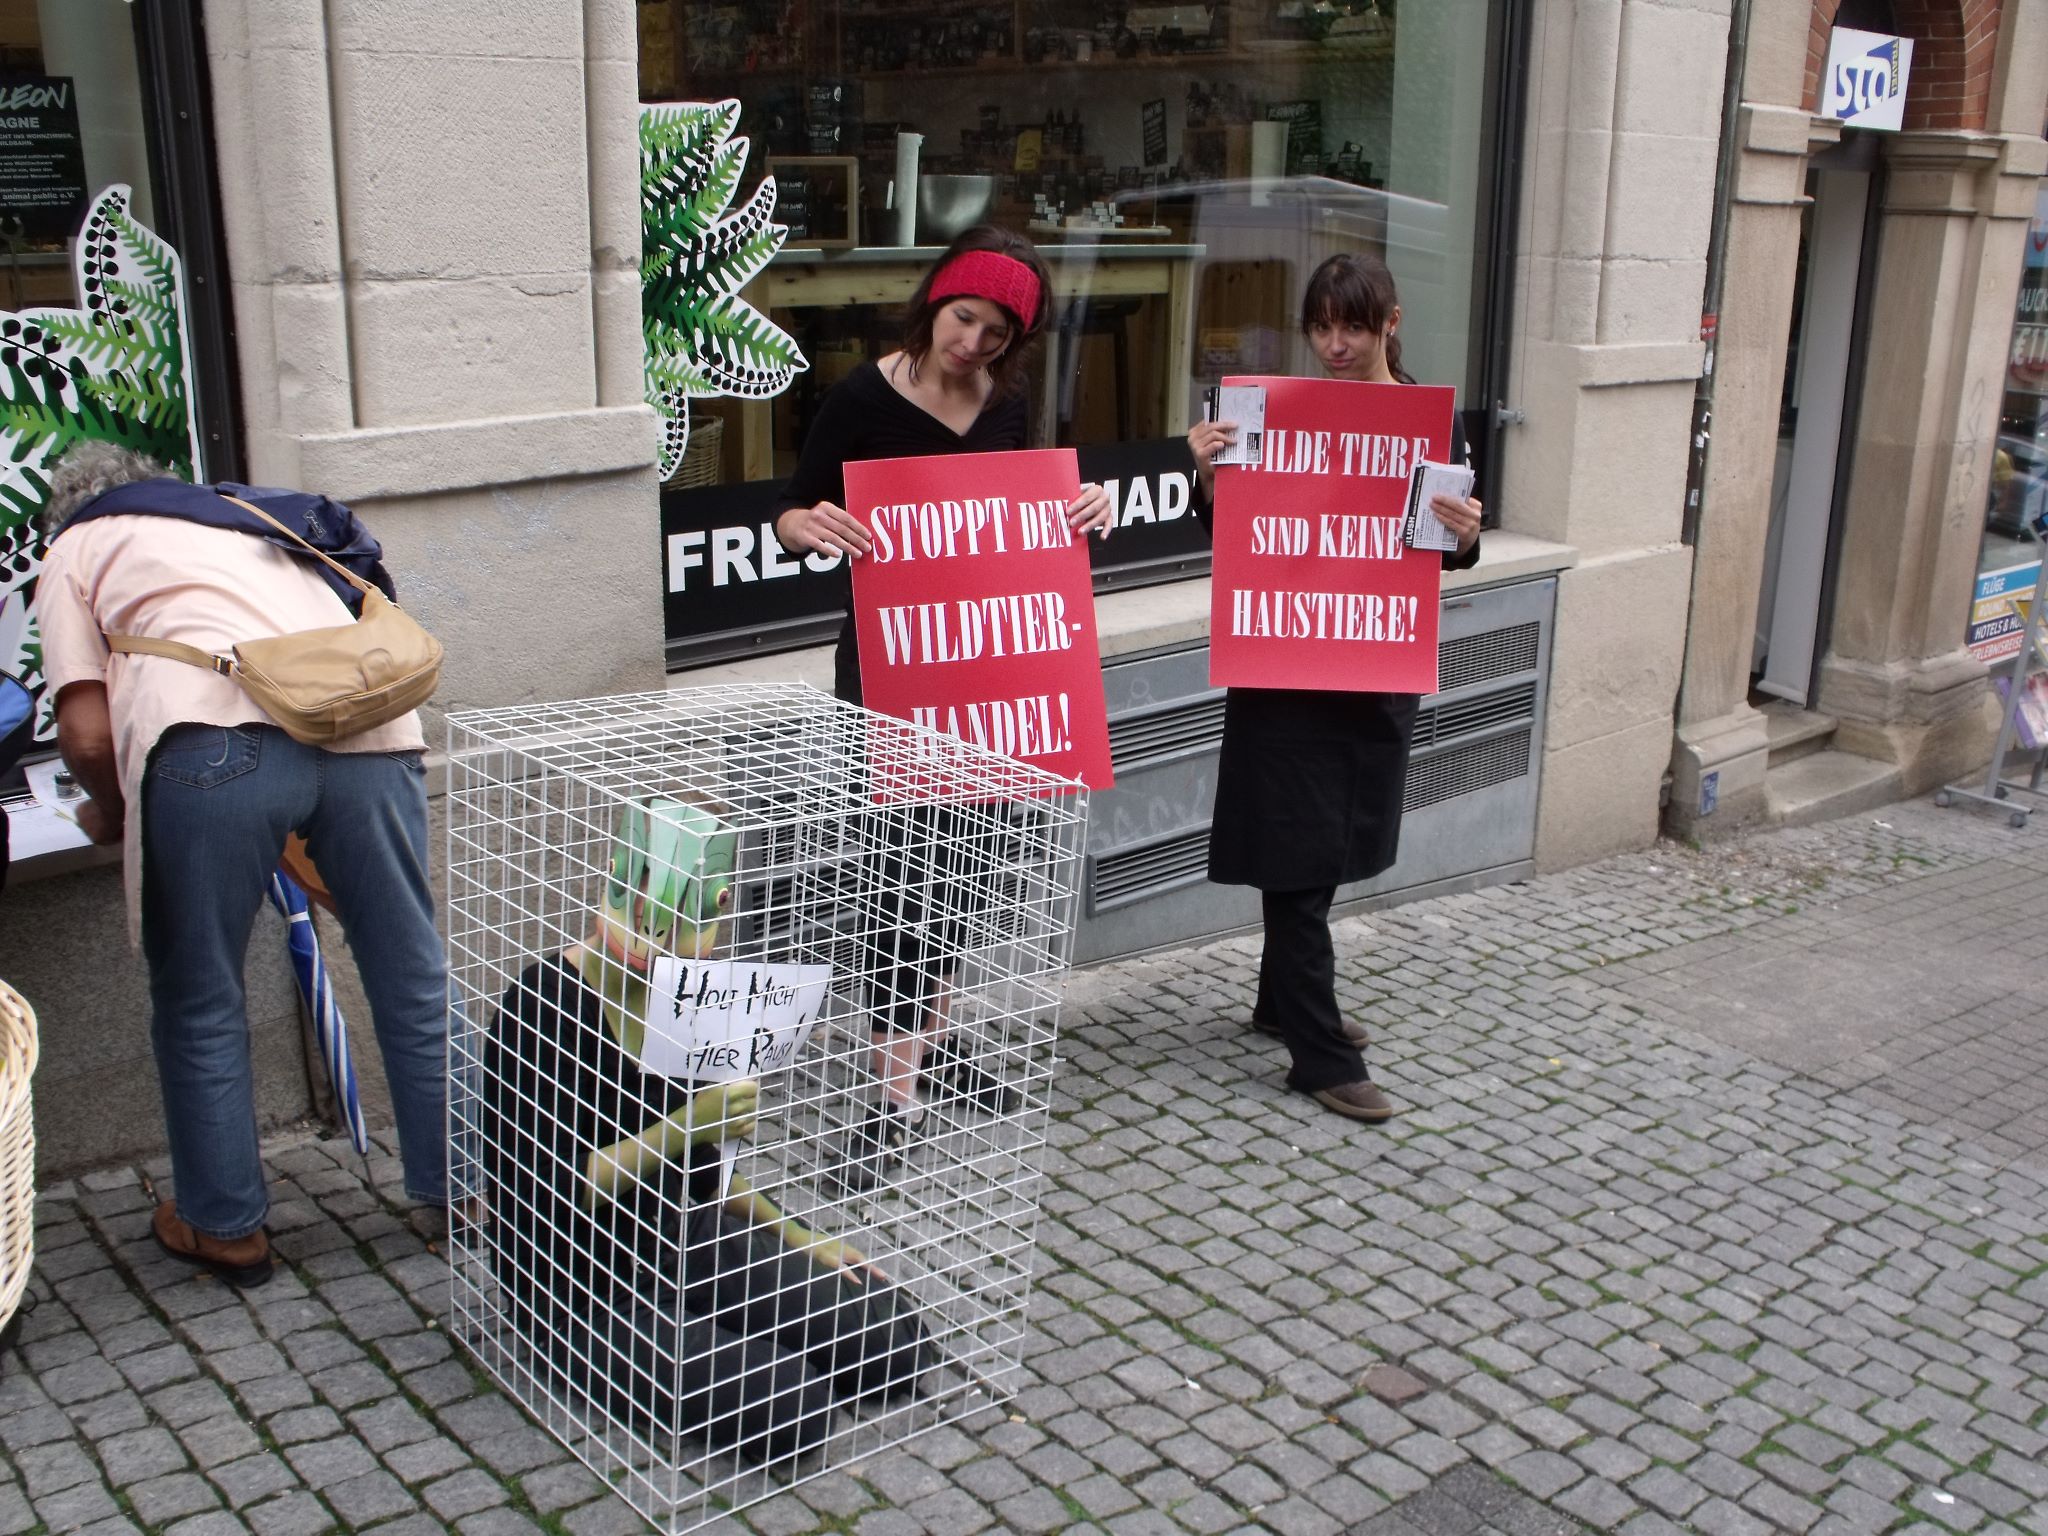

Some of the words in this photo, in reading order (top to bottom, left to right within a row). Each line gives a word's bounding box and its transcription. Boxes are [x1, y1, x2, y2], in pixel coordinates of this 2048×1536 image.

[1891, 41, 1899, 96] TRAVEL
[1241, 430, 1331, 474] ILDE
[870, 497, 1009, 564] STOPPT
[1018, 499, 1073, 551] DEN
[1252, 515, 1310, 556] SIND
[1317, 514, 1403, 561] KEINE
[1406, 516, 1416, 541] LUSH
[1982, 576, 2006, 596] FLÜGE
[877, 592, 1082, 666] WILDTIER-
[1231, 589, 1418, 643] HAUSTIERE!
[1975, 620, 2003, 640] HOTELS
[2003, 618, 2009, 633] &
[911, 692, 1073, 763] HANDEL!
